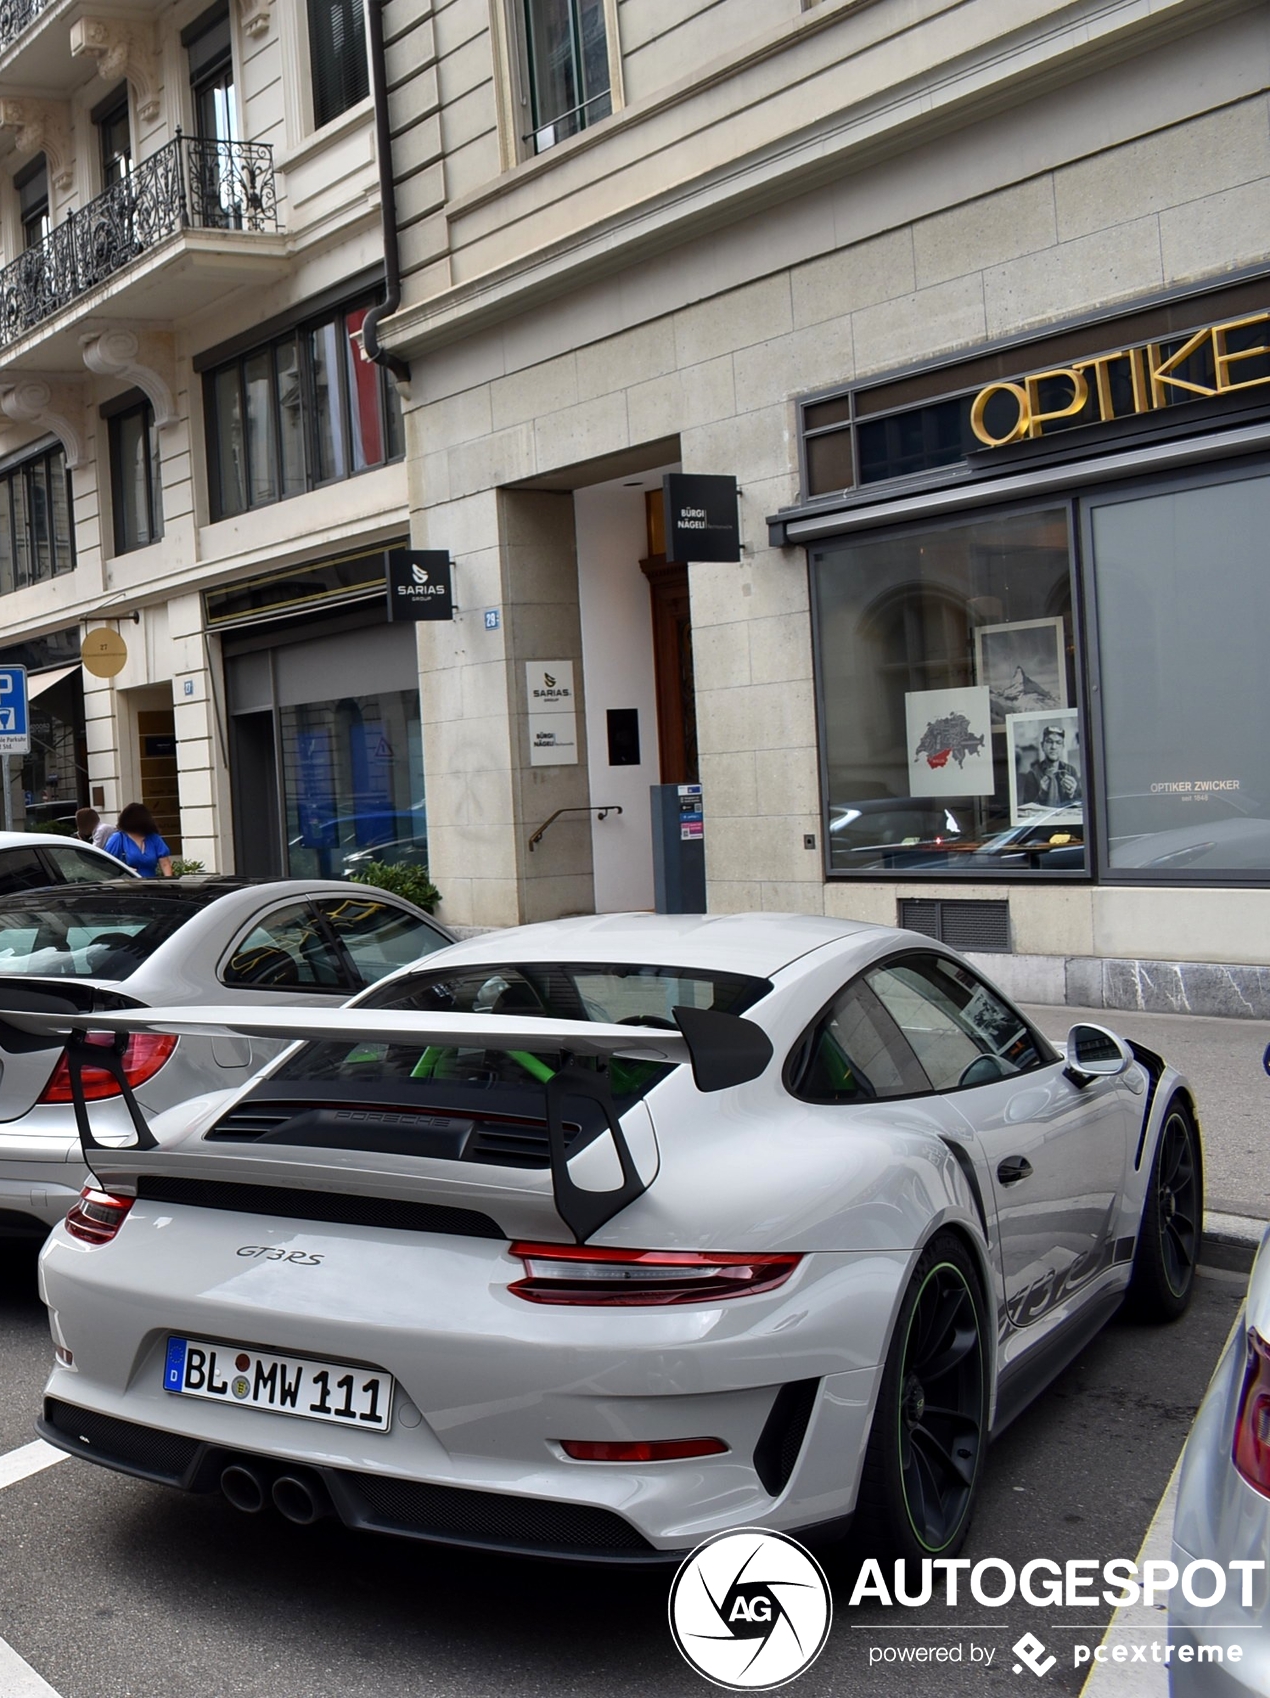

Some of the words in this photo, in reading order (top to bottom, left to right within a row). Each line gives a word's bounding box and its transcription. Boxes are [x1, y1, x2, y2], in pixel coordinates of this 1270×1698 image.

[681, 506, 705, 518] BÜRGI
[678, 518, 705, 529] NÄGELI
[398, 585, 445, 595] SARIAS
[486, 612, 496, 628] 29
[533, 689, 569, 697] SARIAS
[1150, 782, 1192, 793] OPTIKER
[1194, 780, 1240, 791] ZWICKER
[334, 1111, 451, 1128] PORSCHE
[170, 1370, 178, 1382] D
[184, 1348, 228, 1395] BL
[252, 1360, 303, 1408] MW
[309, 1370, 383, 1423] 111
